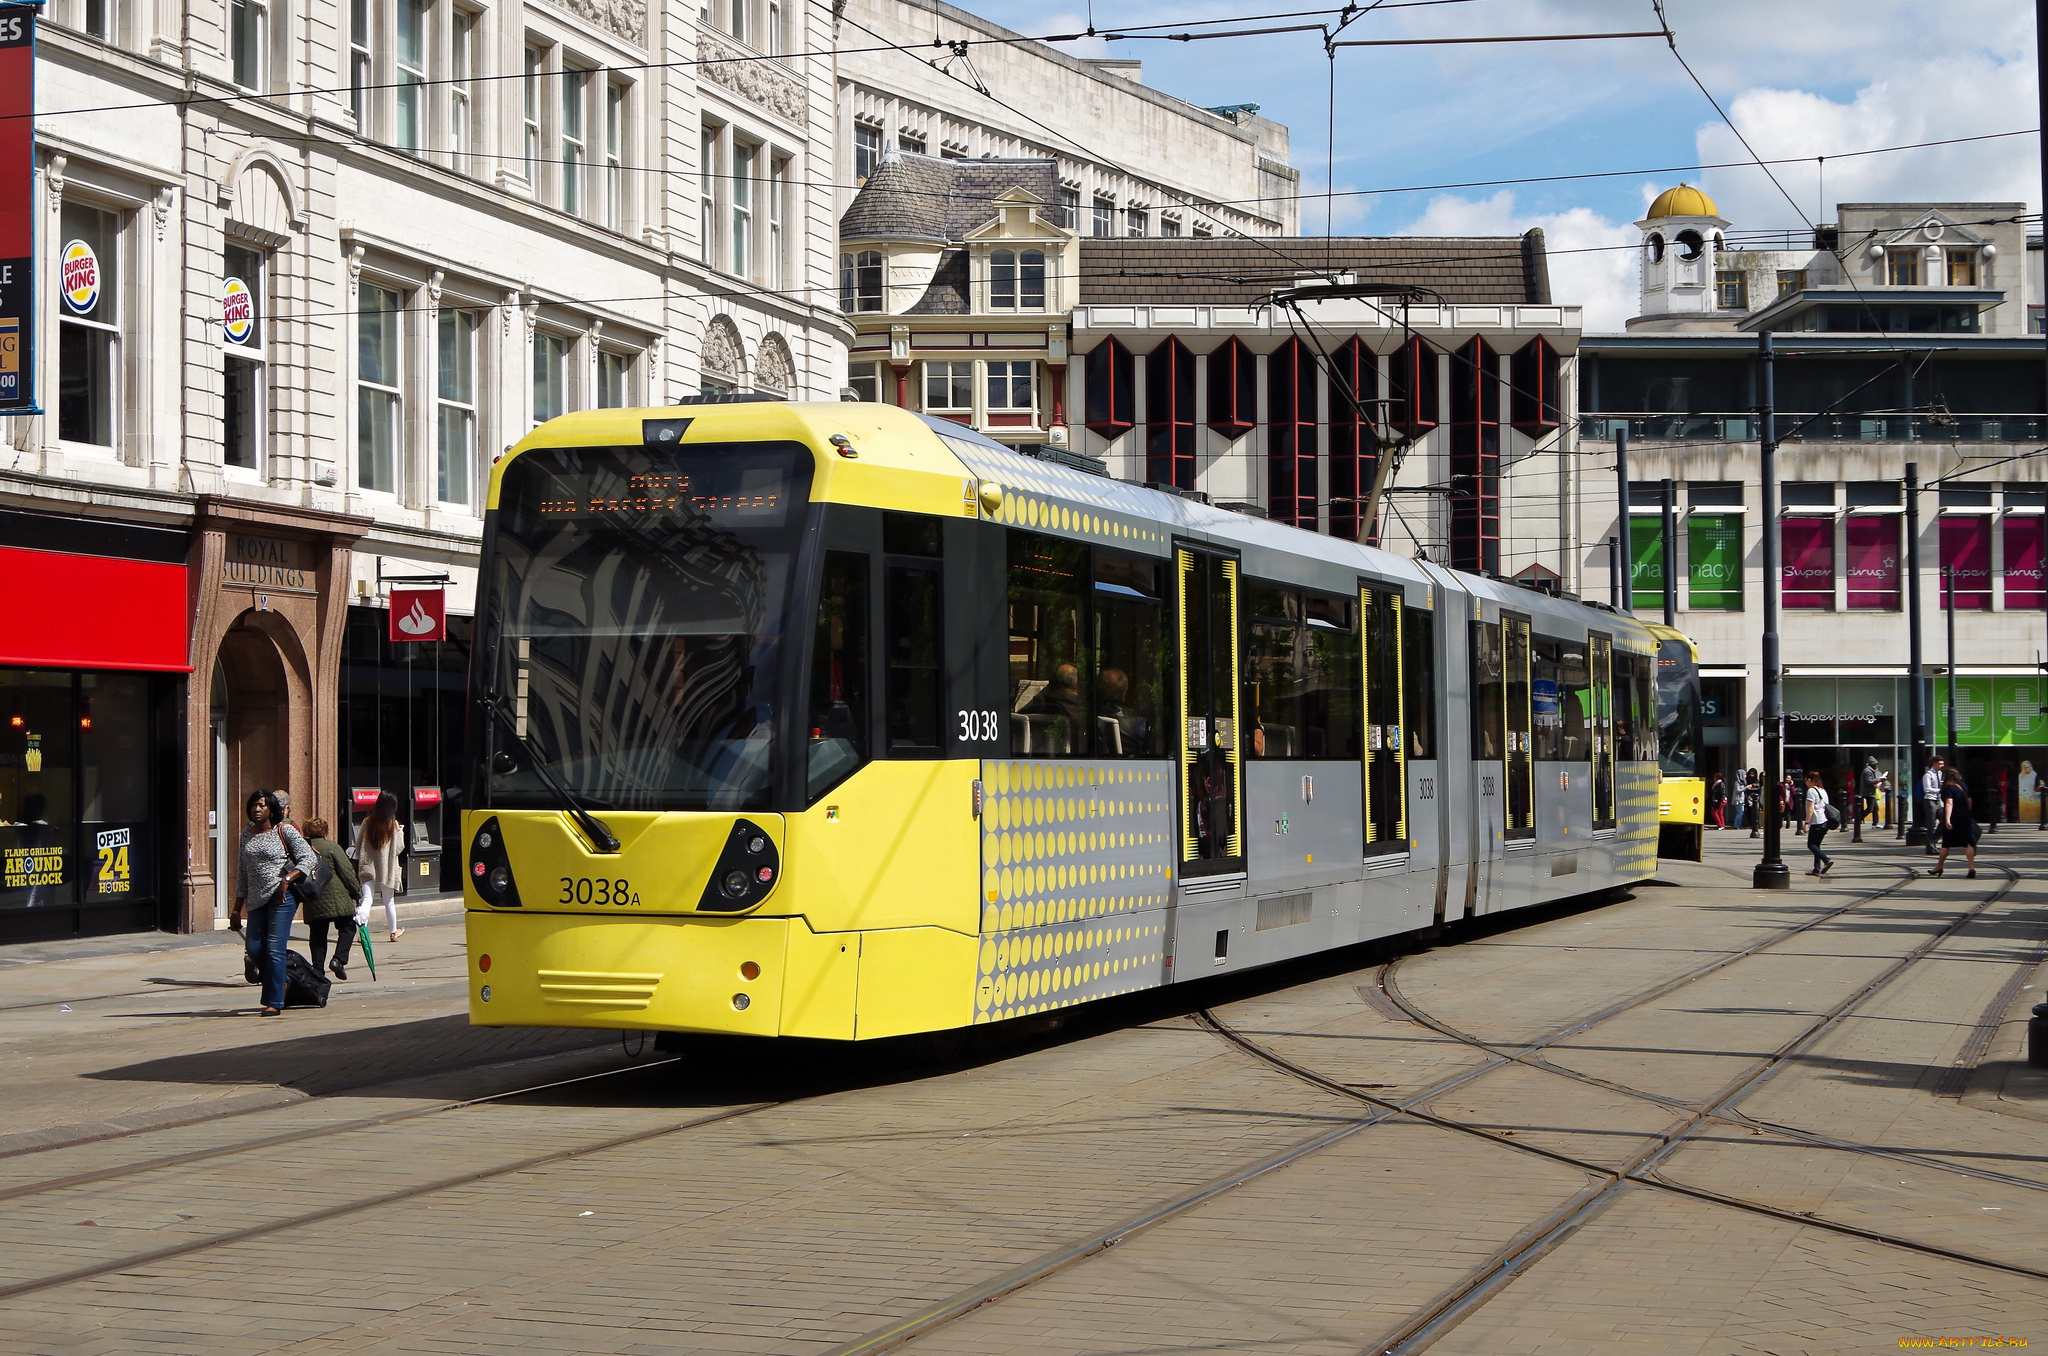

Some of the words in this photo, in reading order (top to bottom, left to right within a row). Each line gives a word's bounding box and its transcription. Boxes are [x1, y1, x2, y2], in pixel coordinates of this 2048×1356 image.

[0, 265, 12, 284] E
[64, 257, 94, 274] BURGER
[65, 269, 95, 293] KING
[223, 292, 249, 309] BURGER
[224, 303, 250, 325] KING
[237, 538, 288, 562] ROYAL
[261, 595, 268, 610] 2
[958, 710, 998, 741] 3038
[1420, 778, 1434, 799] 3038
[98, 830, 128, 847] OPEN
[5, 848, 29, 857] FLAME
[30, 847, 63, 856] GRILLING
[5, 856, 63, 874] AROUND
[98, 846, 130, 880] 24
[5, 874, 27, 887] THE
[29, 872, 63, 886] CLOCK
[98, 880, 130, 894] HOURS
